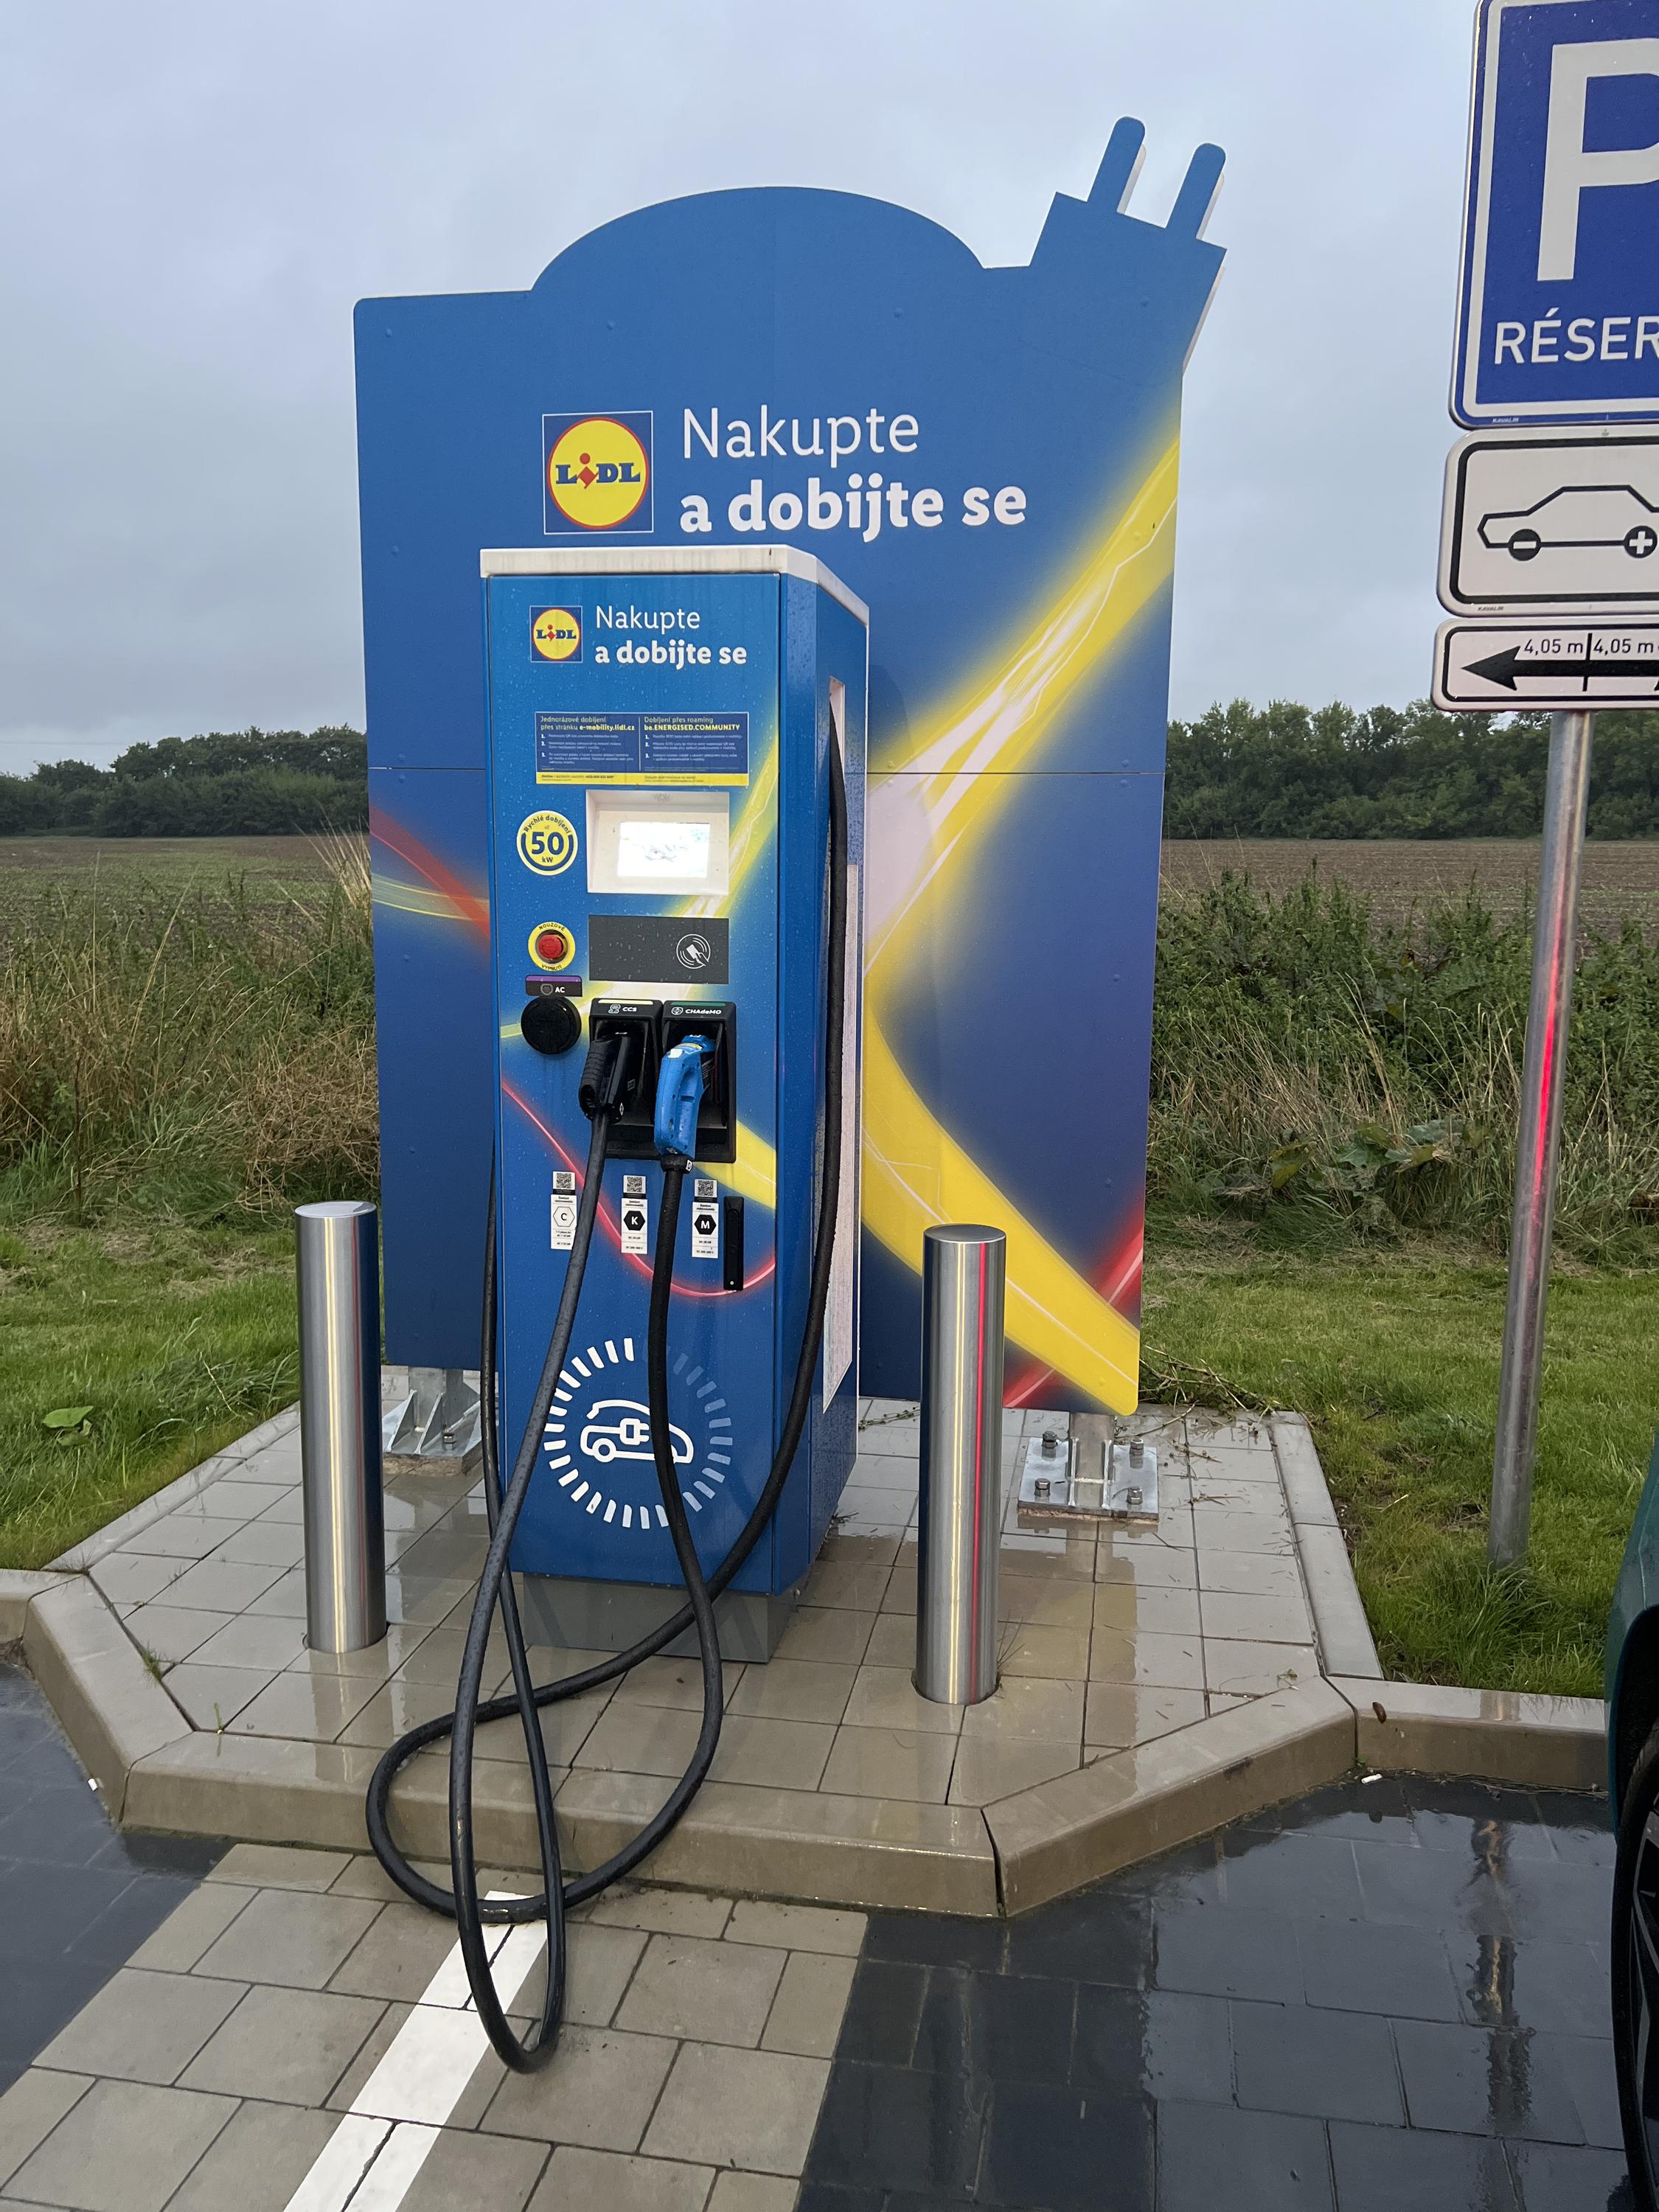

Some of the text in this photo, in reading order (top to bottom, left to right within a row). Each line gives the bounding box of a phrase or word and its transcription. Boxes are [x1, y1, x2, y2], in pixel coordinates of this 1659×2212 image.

[1537, 38, 1659, 281] P
[683, 405, 919, 467] Nakupte
[680, 473, 1026, 542] a dobijte se
[596, 605, 700, 635] Nakupte
[595, 639, 748, 669] a dobijte se
[1524, 638, 1654, 655] 4,05 m 4,05 m
[580, 723, 635, 732] e-mobility.lidl.cz
[524, 815, 544, 832] Rychlé
[531, 832, 564, 855] 50
[560, 1213, 567, 1221] C
[631, 1217, 639, 1225] K
[700, 1220, 710, 1229] M
